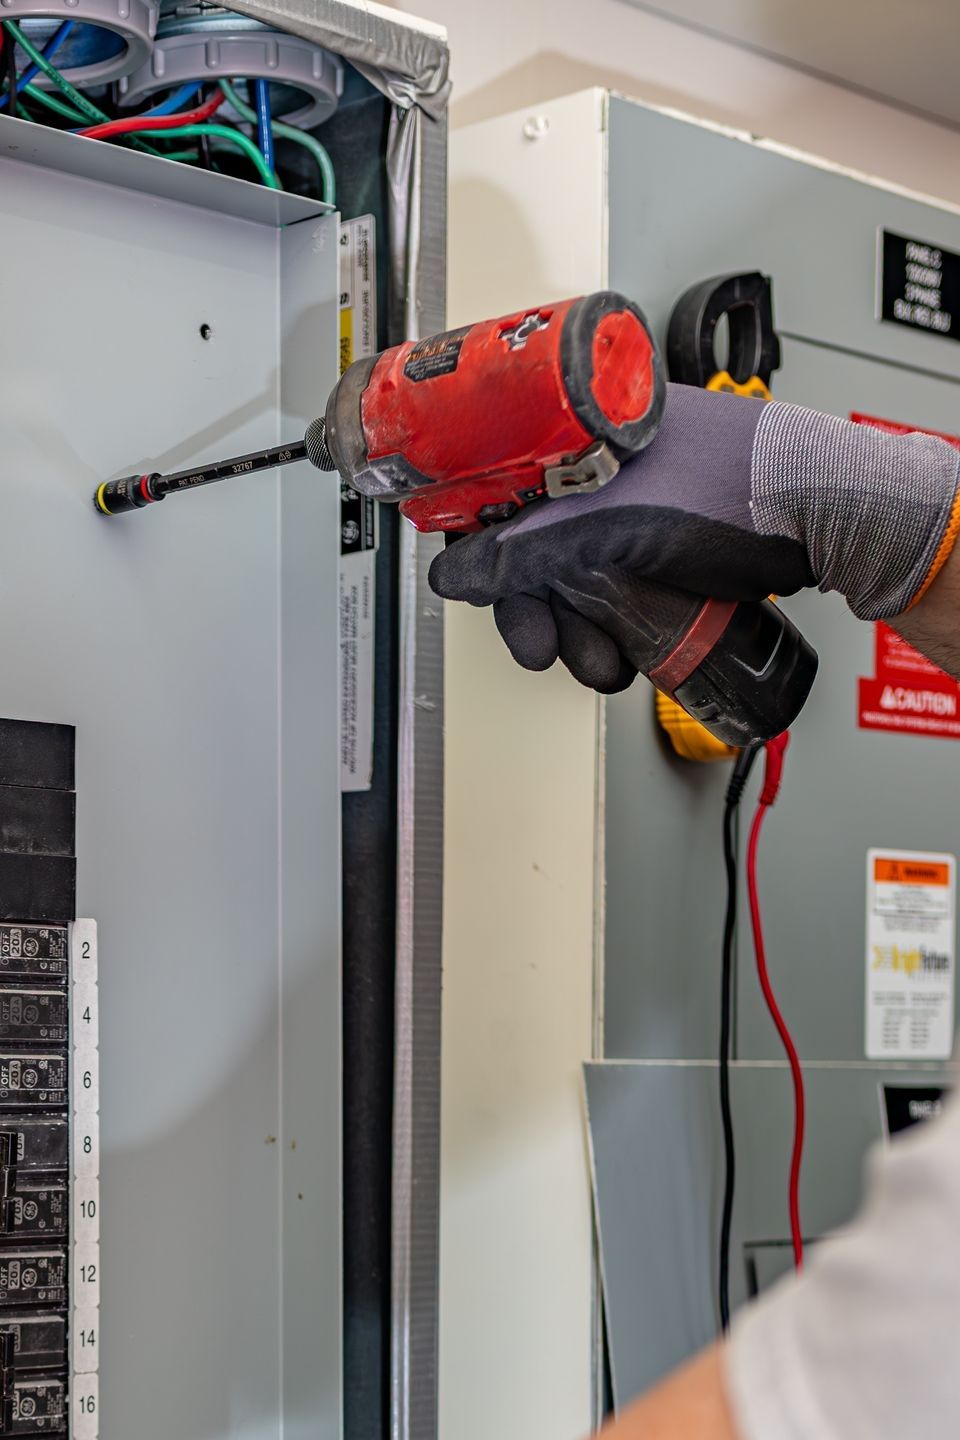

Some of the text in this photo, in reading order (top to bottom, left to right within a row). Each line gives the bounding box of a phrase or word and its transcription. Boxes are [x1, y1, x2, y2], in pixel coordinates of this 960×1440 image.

[231, 461, 253, 474] 32767
[895, 687, 957, 716] CAUTION
[81, 941, 90, 959] 2
[82, 1006, 91, 1024] 4
[83, 1070, 92, 1089] 6
[83, 1135, 92, 1154] 8
[80, 1200, 96, 1218] 10
[80, 1264, 96, 1283] 12
[80, 1329, 95, 1347] 14
[79, 1395, 95, 1414] 16
